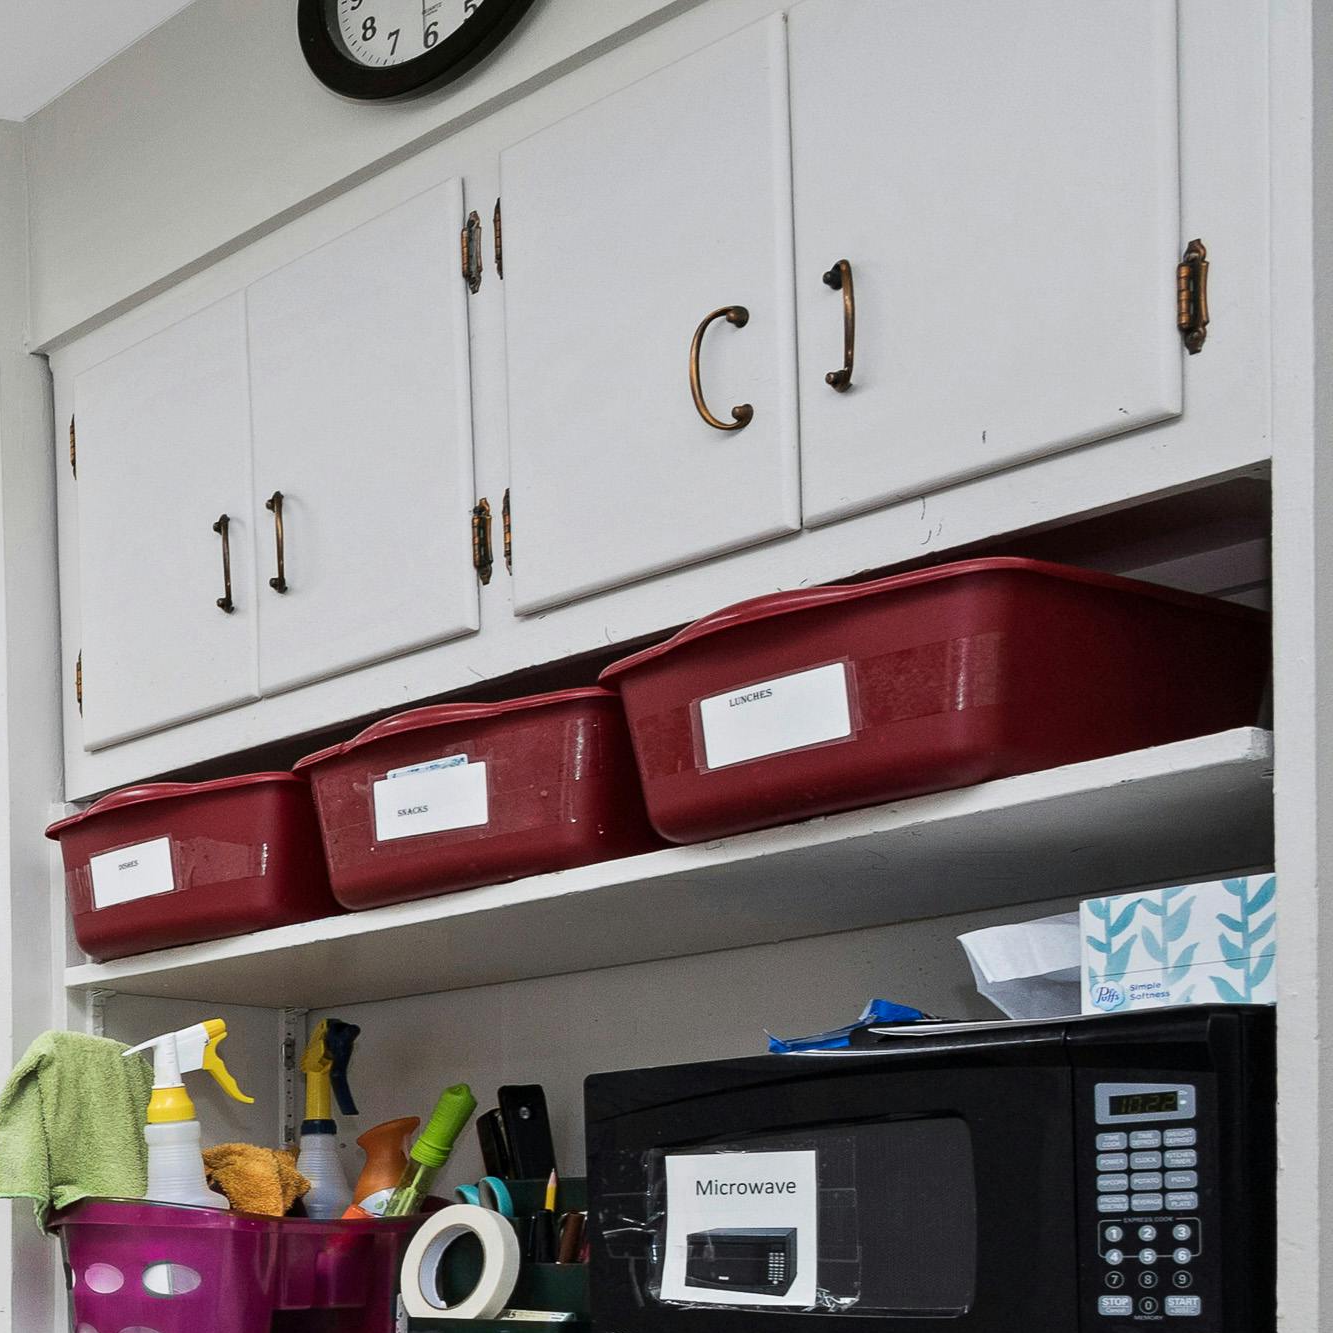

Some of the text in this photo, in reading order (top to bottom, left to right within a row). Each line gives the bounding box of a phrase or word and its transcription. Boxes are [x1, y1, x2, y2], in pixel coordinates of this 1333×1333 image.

[361, 15, 377, 42] 8
[422, 20, 439, 49] 6
[387, 27, 401, 57] 7
[728, 688, 774, 708] LUNCHES
[397, 804, 430, 818] SNACKS
[1129, 981, 1162, 992] Simple
[1095, 986, 1120, 1004] Puffs
[1129, 991, 1171, 1001] Softness
[695, 1178, 797, 1197] Microwave
[1154, 1215, 1174, 1223] COOK
[1111, 1228, 1118, 1239] 1
[1142, 1227, 1153, 1239] 2
[1177, 1226, 1187, 1238] 3
[1109, 1251, 1119, 1263] 4
[1143, 1250, 1153, 1262] 5
[1177, 1250, 1187, 1261] 6
[1110, 1274, 1120, 1285] 7
[1144, 1274, 1153, 1285] 8
[1178, 1274, 1187, 1285] 9
[1101, 1297, 1129, 1306] STOP
[1144, 1300, 1153, 1311] 0
[1167, 1297, 1200, 1306] START
